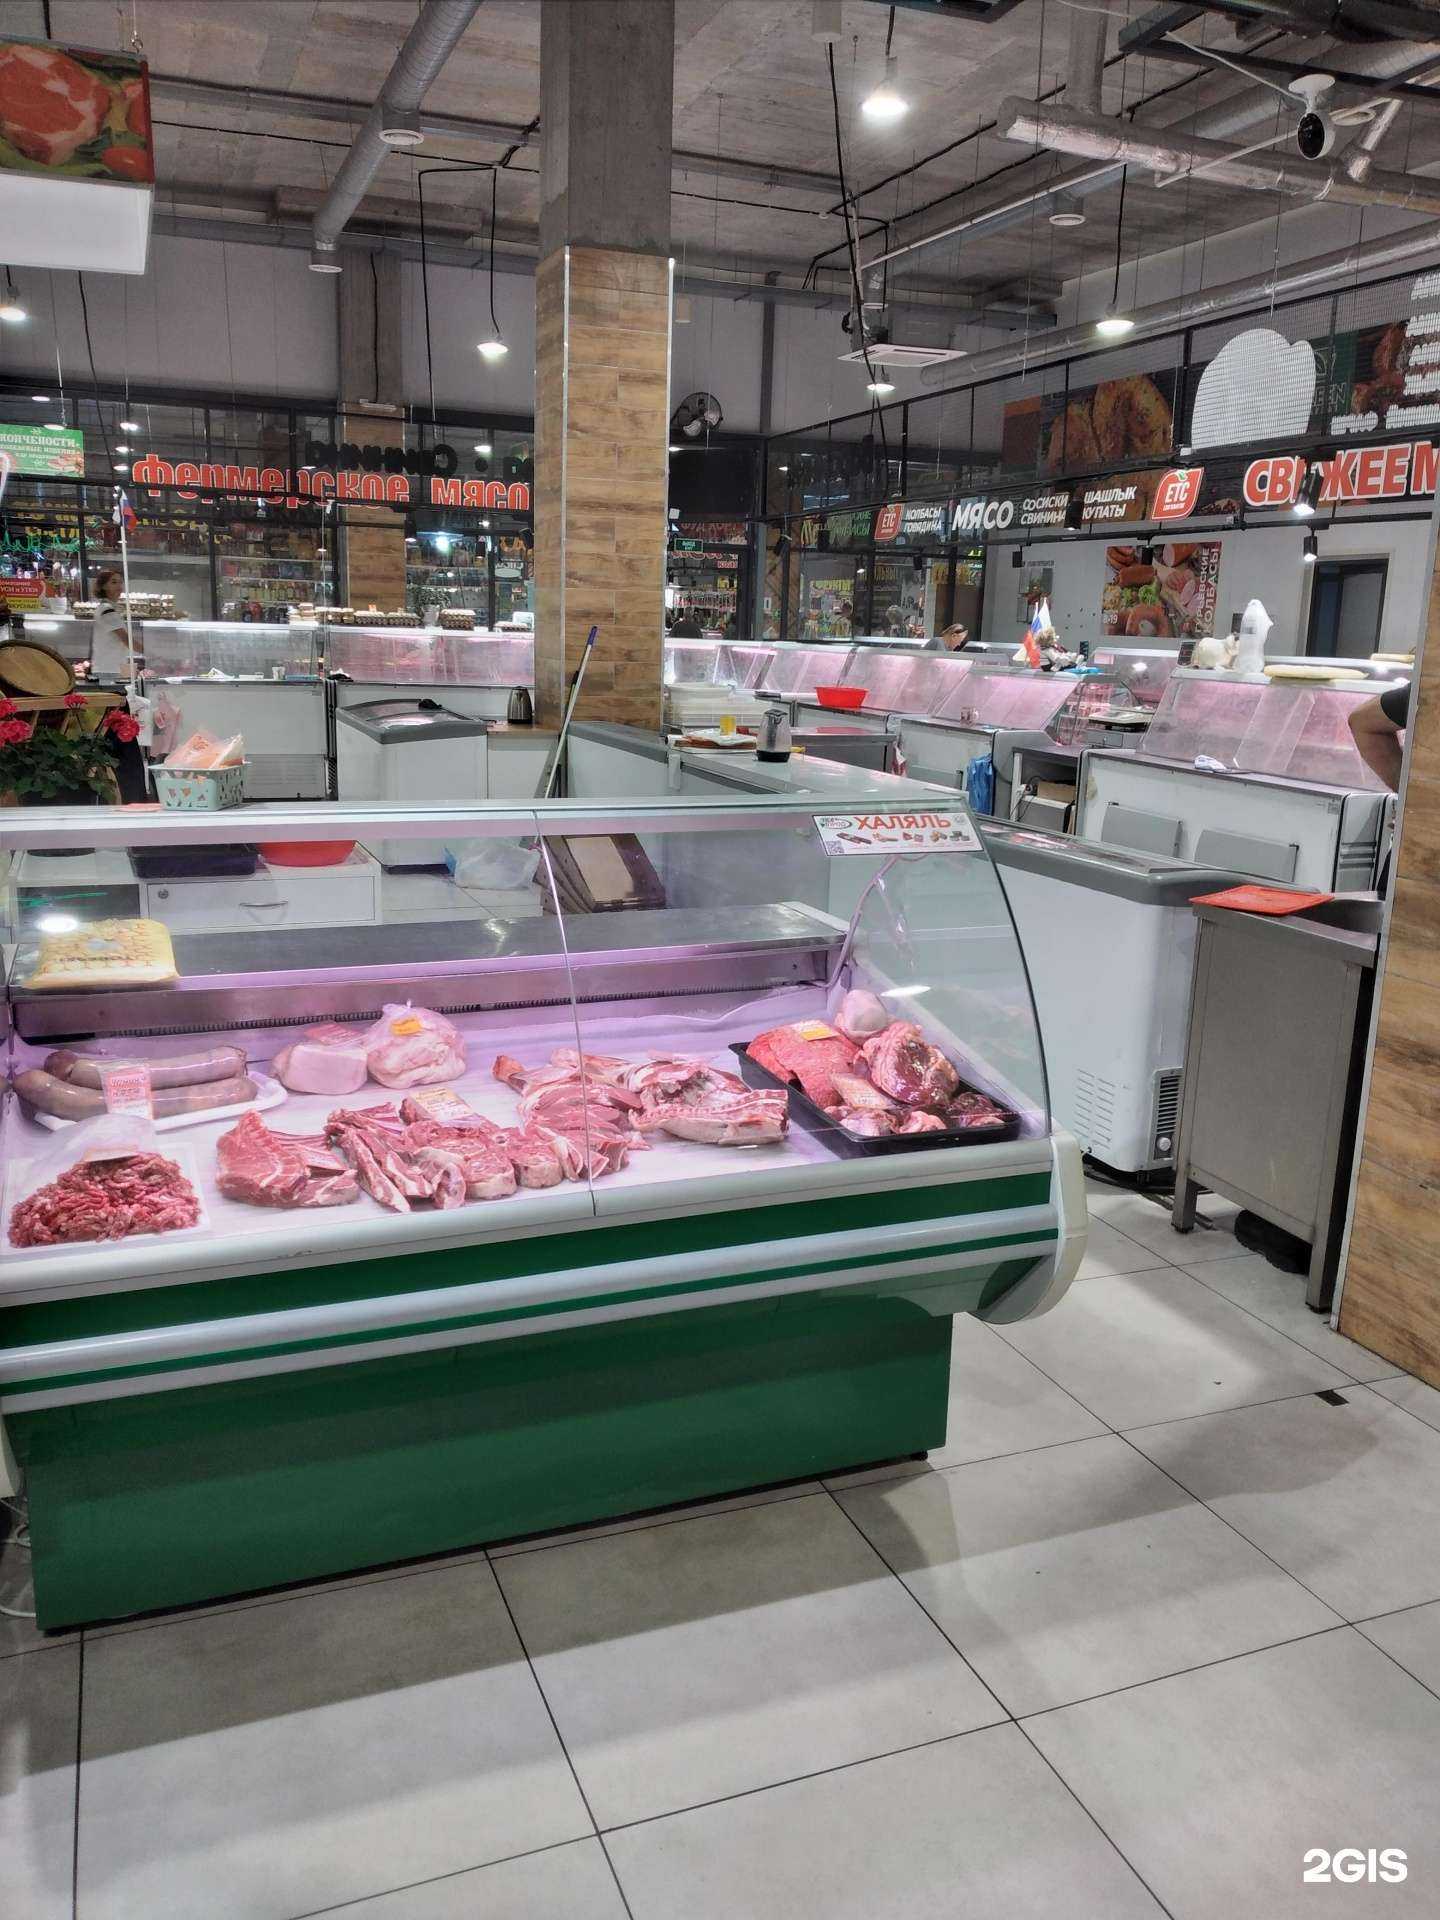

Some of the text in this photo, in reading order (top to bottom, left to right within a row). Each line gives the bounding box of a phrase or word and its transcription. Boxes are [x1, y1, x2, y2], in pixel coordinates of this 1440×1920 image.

[431, 477, 530, 511] мясо
[1023, 494, 1069, 511] СОСИСКИ
[1084, 486, 1137, 504] ШАШЛЫК
[905, 506, 942, 520] КОЛБАСЫ
[952, 500, 1014, 530] МЯСО
[1021, 510, 1066, 525] СВИНИНА
[1082, 503, 1127, 520] КУПАТЫ
[903, 519, 942, 534] ГОВЯДИНА
[1203, 548, 1219, 634] КОЛБАСЫ
[853, 815, 952, 830] ХАЛЯЛЬ
